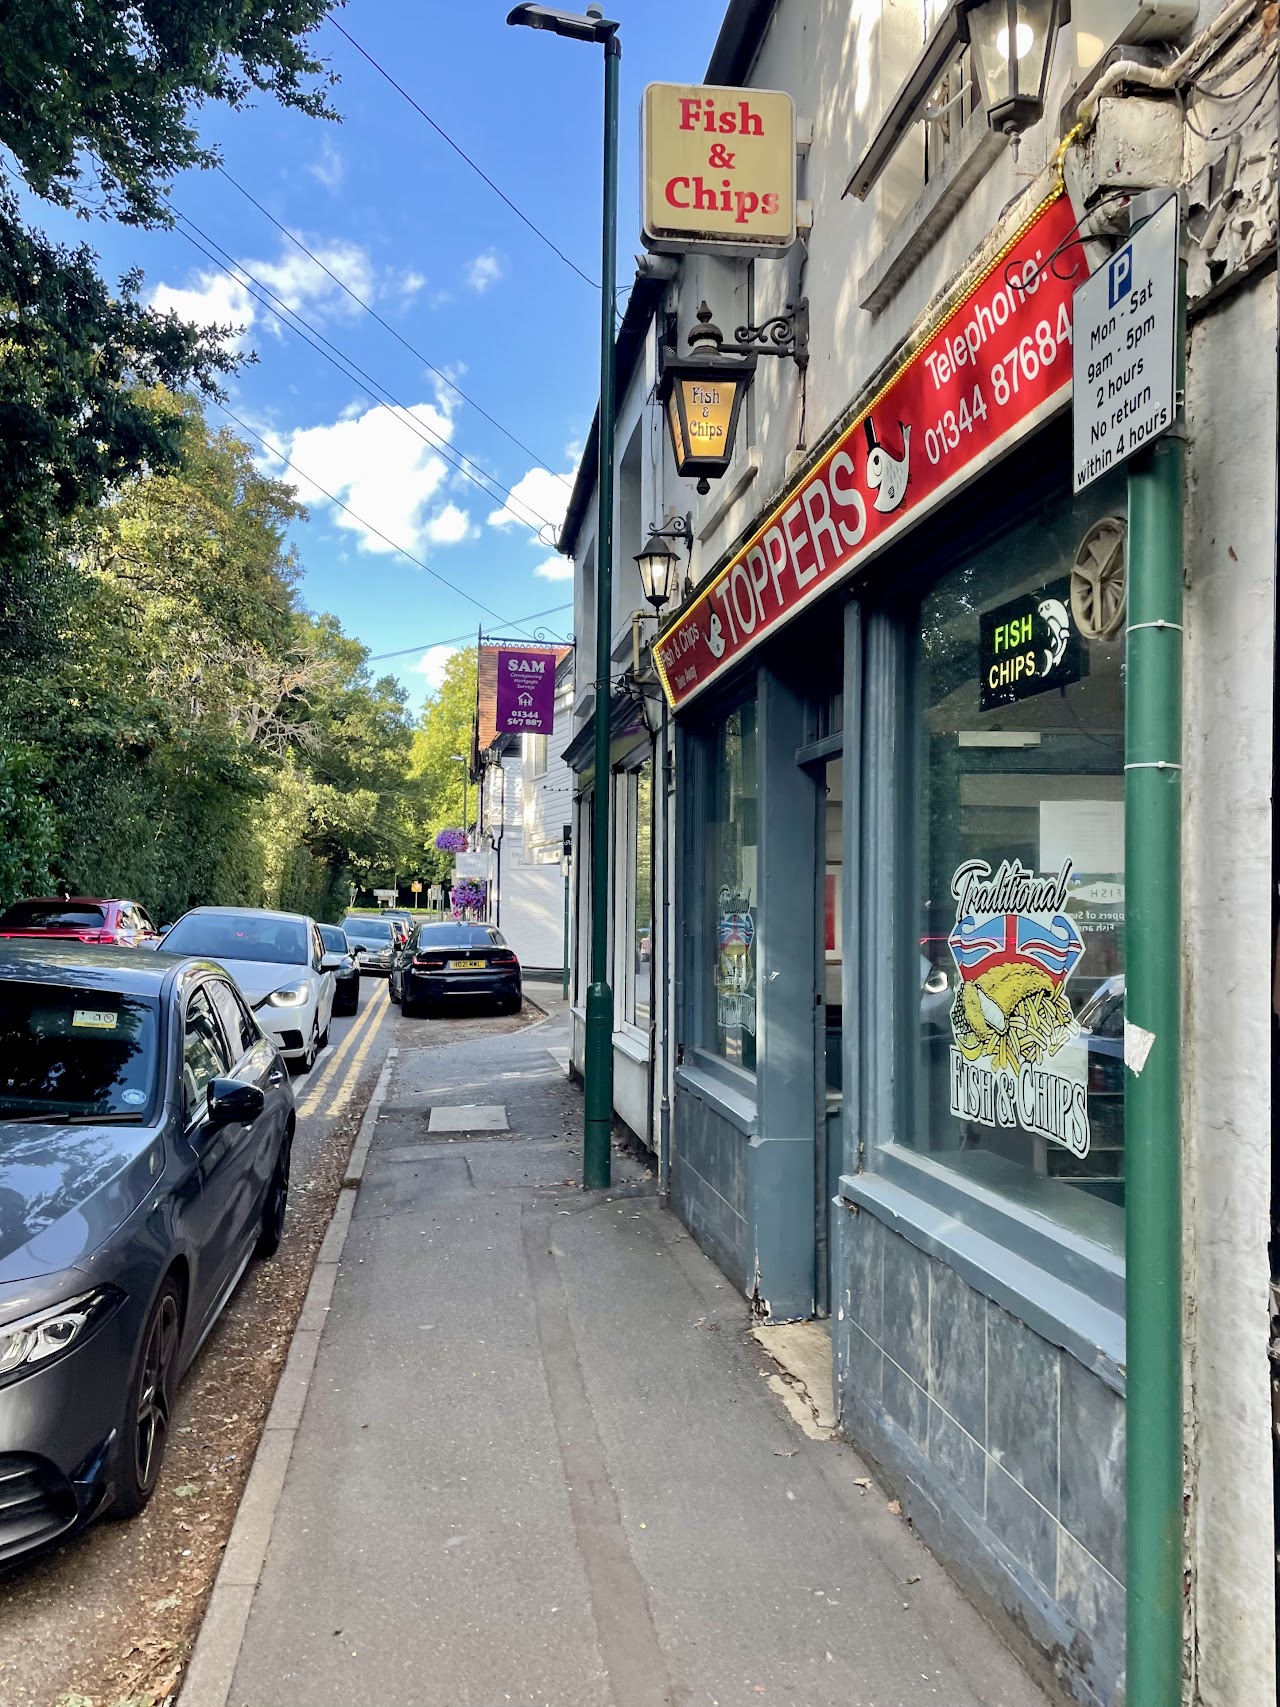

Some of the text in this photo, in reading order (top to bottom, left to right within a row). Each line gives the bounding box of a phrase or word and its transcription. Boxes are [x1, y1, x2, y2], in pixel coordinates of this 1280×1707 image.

[679, 98, 764, 136] Fish
[708, 143, 735, 169] &
[665, 177, 779, 223] Chips
[1113, 255, 1130, 301] P
[924, 249, 1049, 391] Telephone:
[1090, 317, 1116, 350] Mon
[1130, 278, 1153, 315] Sat
[1087, 352, 1113, 384] 9am
[1126, 315, 1155, 351] 5pm
[692, 387, 720, 404] Fish
[1096, 358, 1144, 409] 2 hours
[690, 420, 723, 440] Chips
[702, 407, 709, 417] &
[924, 384, 987, 465] 01344
[1090, 386, 1151, 445] No return
[1077, 406, 1167, 486] within 4 hours
[715, 451, 867, 645] TOPPERS
[672, 638, 682, 659] &
[678, 622, 700, 653] Chips
[994, 614, 1033, 654] FISH
[508, 659, 545, 673] SAM
[989, 651, 1036, 689] CHIPS
[511, 710, 539, 718] 01344
[952, 858, 1073, 924] Traditional
[951, 1048, 1088, 1154] FISH & CHIPS
